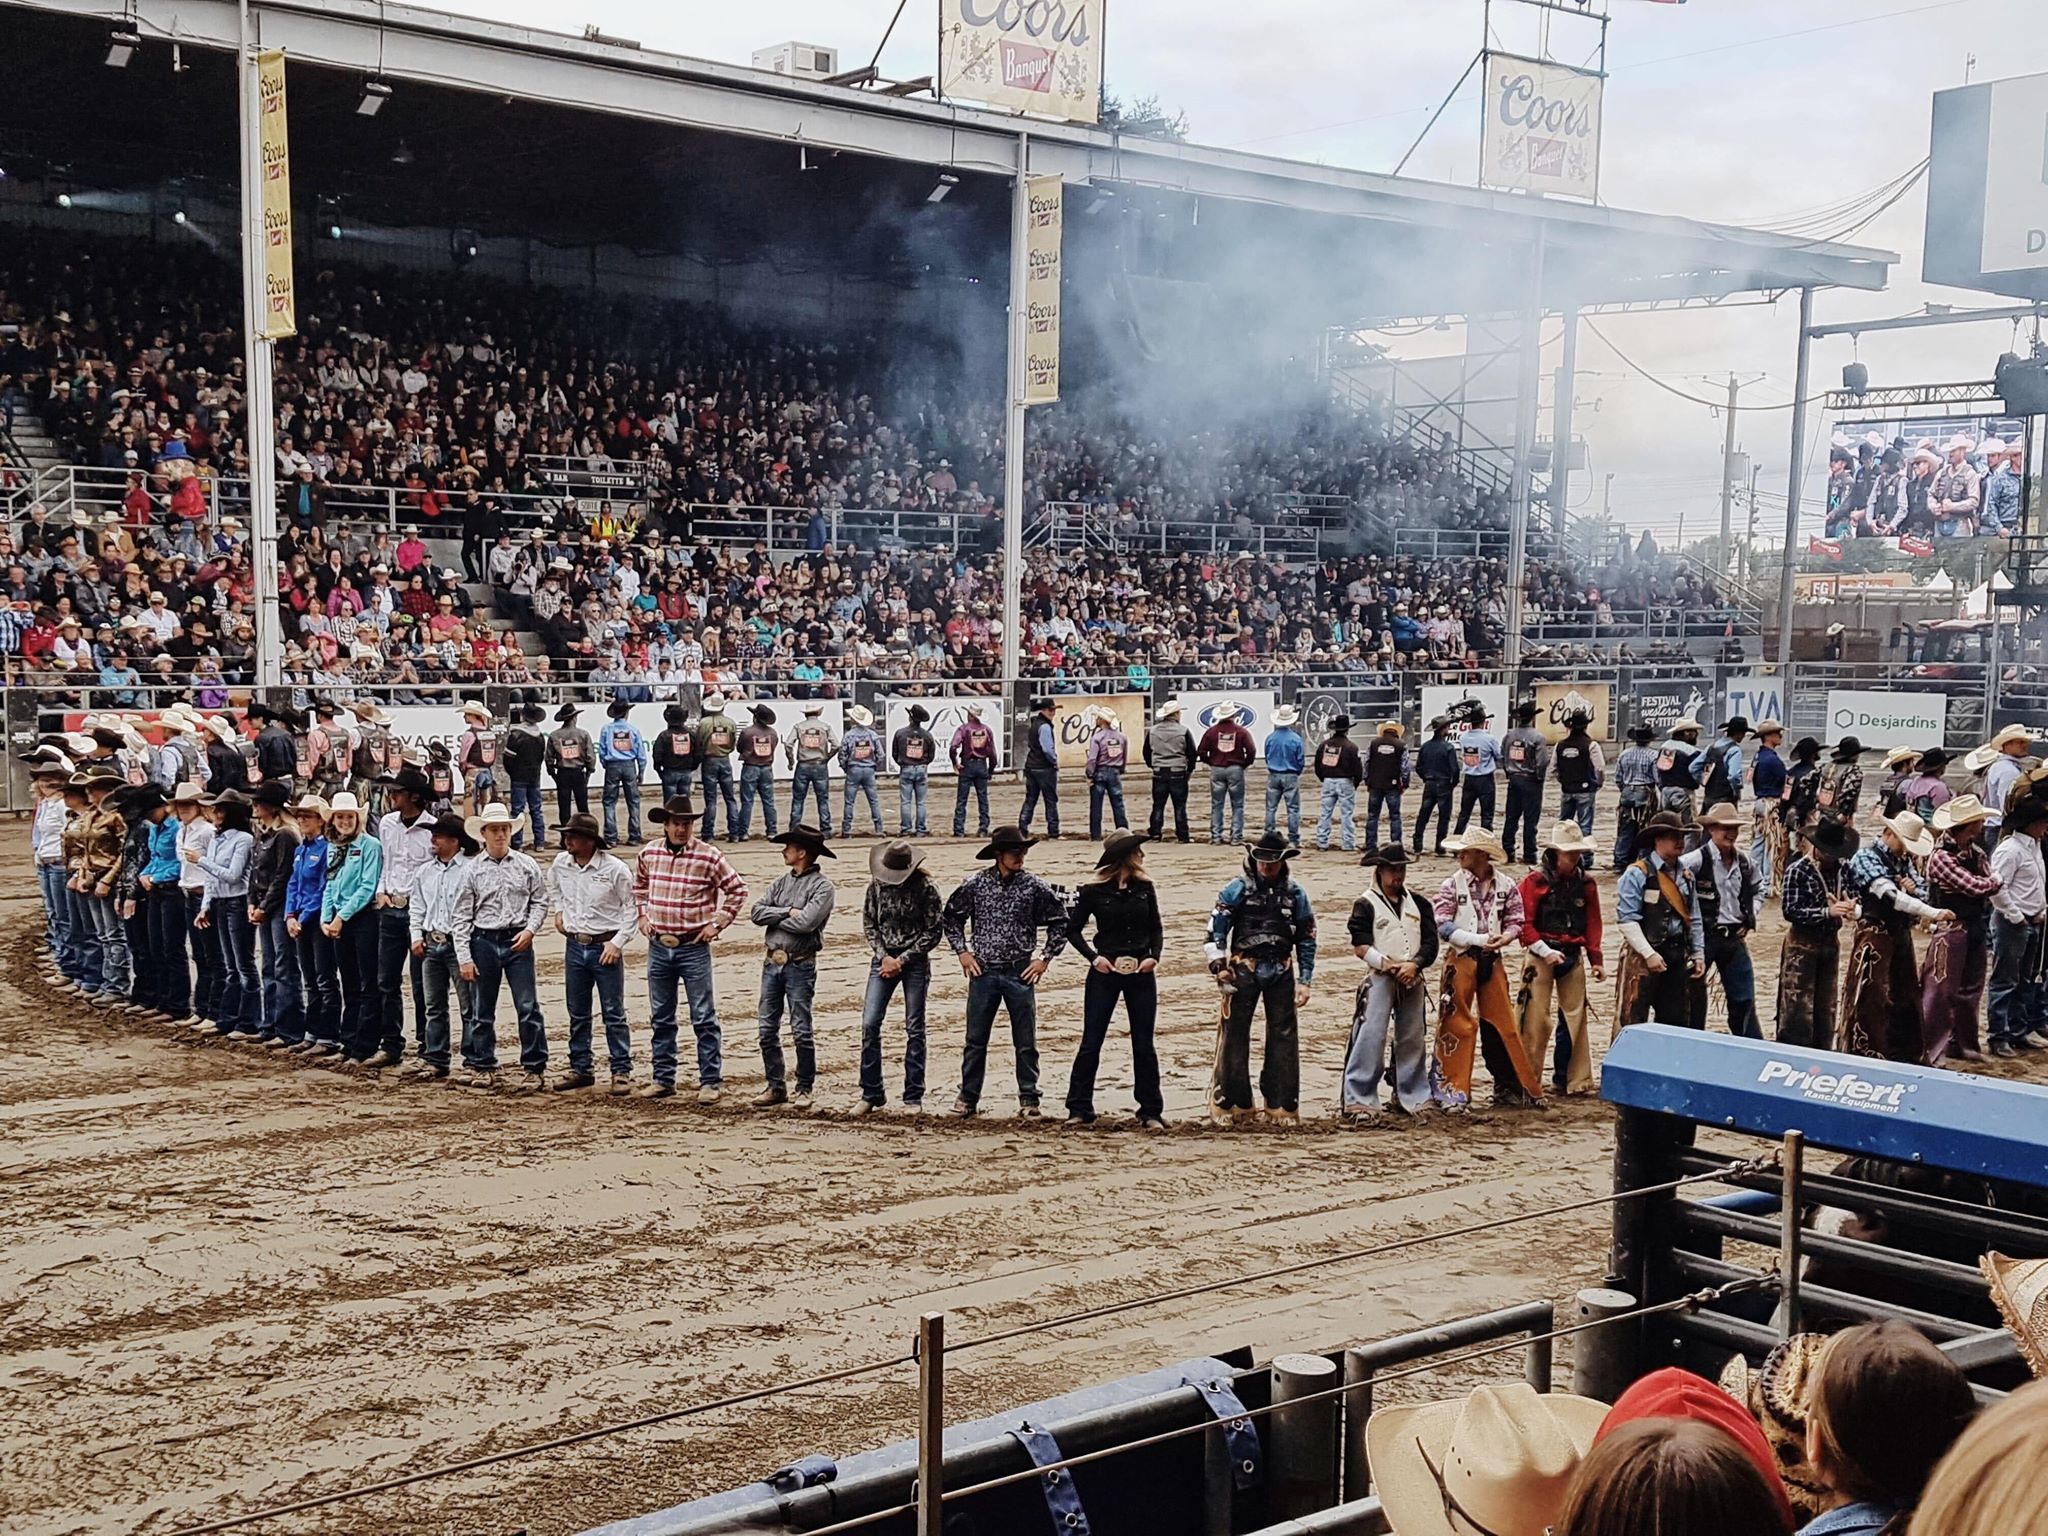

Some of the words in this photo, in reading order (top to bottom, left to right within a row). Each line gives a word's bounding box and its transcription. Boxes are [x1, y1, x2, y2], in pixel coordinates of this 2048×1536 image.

[1006, 47, 1051, 83] Banquet
[260, 75, 284, 98] Coors
[1500, 74, 1591, 138] Coors
[262, 141, 286, 164] Coors
[1030, 195, 1060, 214] Coors
[264, 207, 289, 230] Coors
[1029, 249, 1058, 267] Coors
[266, 273, 291, 296] Coors
[1028, 302, 1057, 320] Coors
[1028, 354, 1057, 372] Coors
[553, 474, 569, 482] BAR
[591, 476, 624, 485] TOILETTE
[1641, 695, 1681, 706] FESTIVAL
[1641, 705, 1681, 717] western
[1730, 690, 1781, 722] TVA
[1859, 713, 1937, 729] Desjardins
[1757, 1060, 1906, 1106] Priefert
[1804, 1090, 1838, 1103] Ranch
[1840, 1096, 1899, 1113] Equipment
